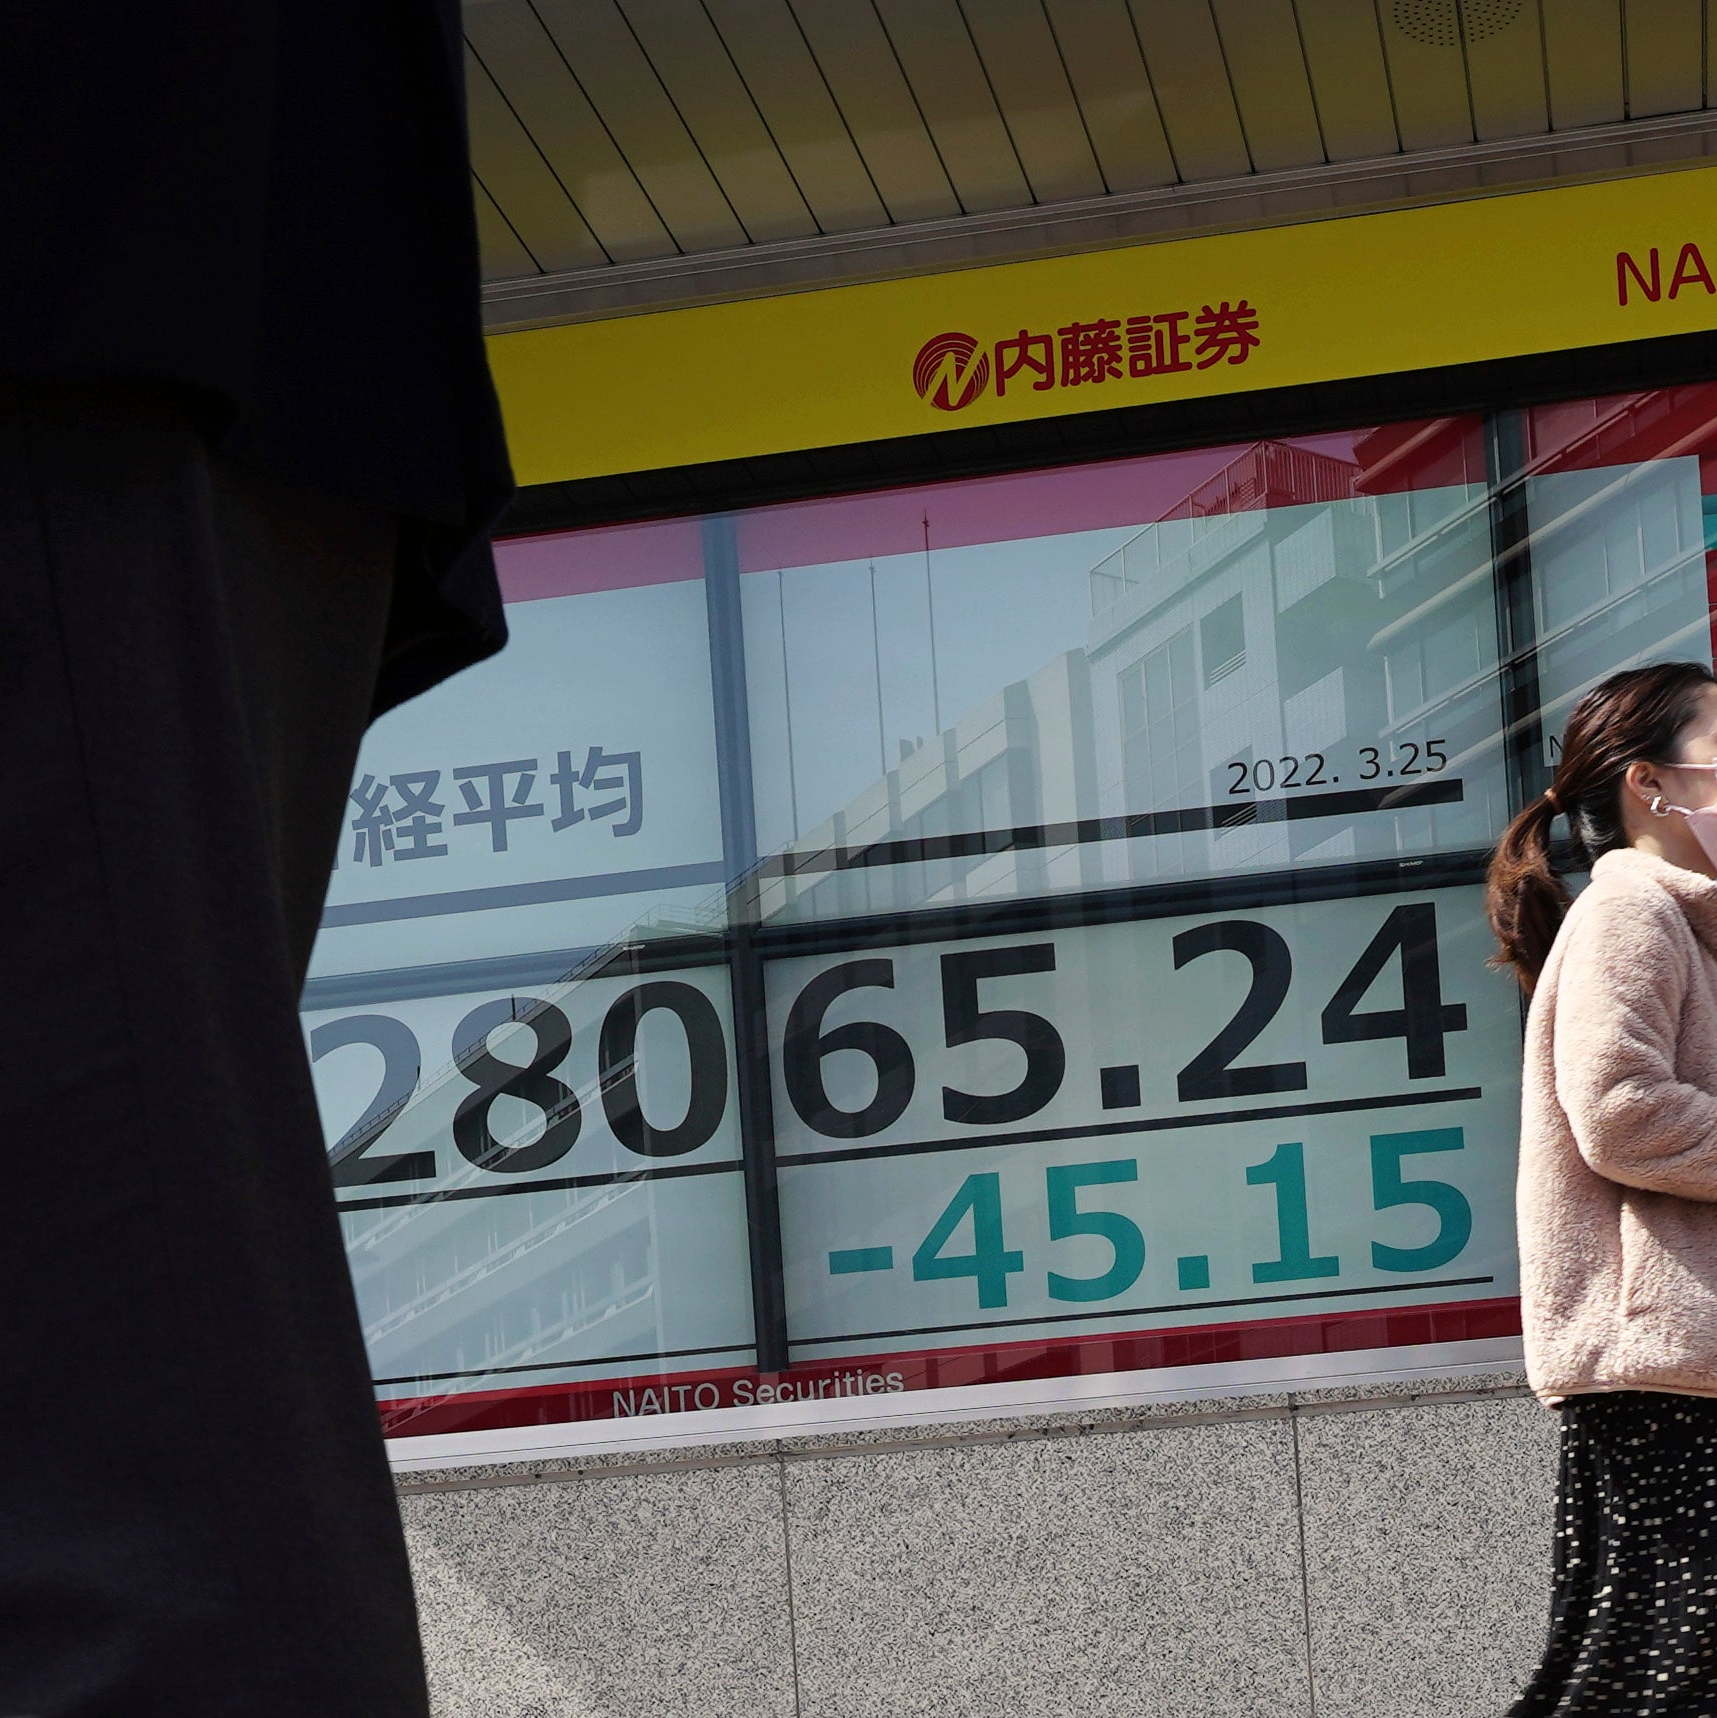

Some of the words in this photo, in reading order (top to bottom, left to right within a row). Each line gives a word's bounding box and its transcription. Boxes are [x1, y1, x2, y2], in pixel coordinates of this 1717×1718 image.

[995, 300, 1260, 397] 内藤証券
[332, 746, 643, 871] 経平均
[310, 903, 1468, 1187] 28065.24
[828, 1127, 1472, 1309] -45.15
[612, 1382, 720, 1418] NAITO
[733, 1370, 904, 1407] Securities
